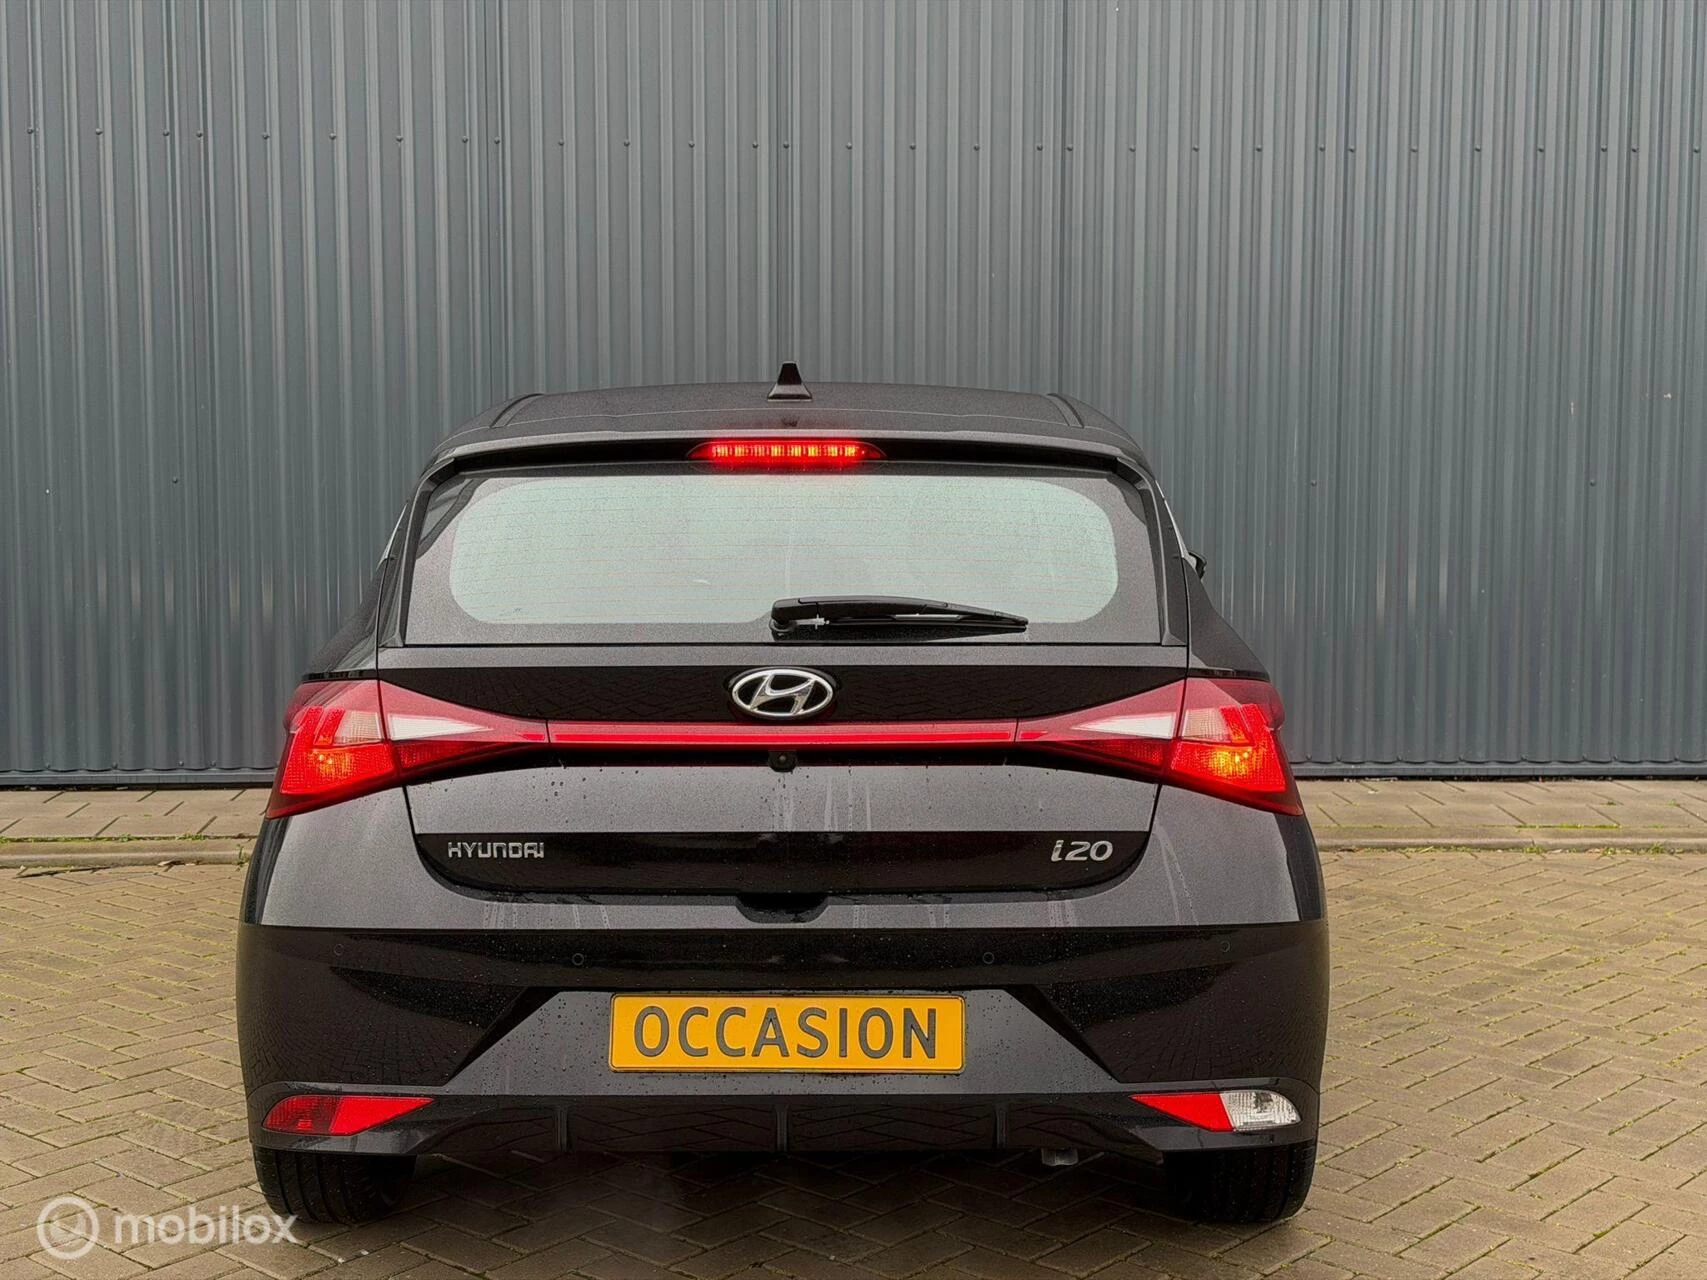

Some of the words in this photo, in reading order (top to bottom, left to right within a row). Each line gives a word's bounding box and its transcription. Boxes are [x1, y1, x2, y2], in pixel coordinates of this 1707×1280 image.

[447, 842, 545, 859] HYUNDAI
[1050, 839, 1114, 862] i20
[633, 1005, 937, 1060] OCCASION
